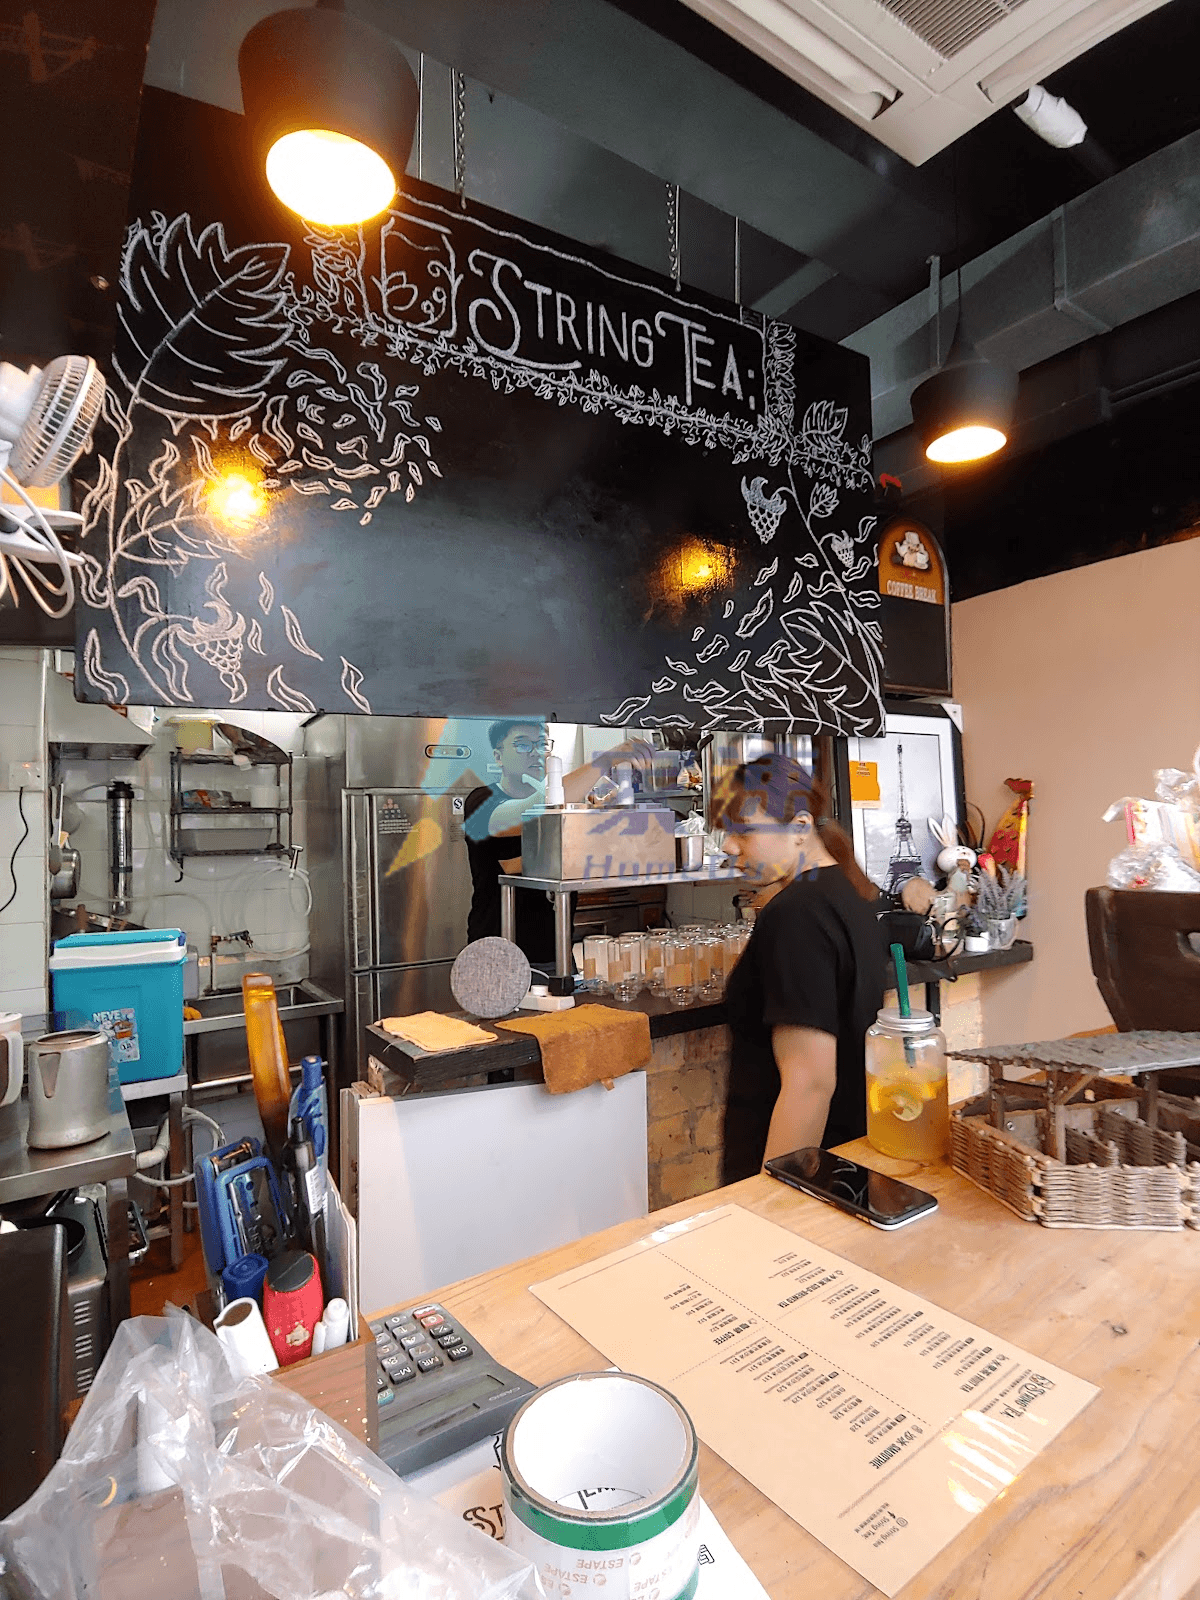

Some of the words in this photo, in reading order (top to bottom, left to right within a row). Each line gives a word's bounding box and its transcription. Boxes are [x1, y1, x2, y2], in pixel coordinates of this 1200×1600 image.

[468, 248, 654, 370] STRING
[886, 579, 914, 599] COFFEE
[914, 585, 937, 604] BREAK
[775, 1300, 790, 1308] TEA
[711, 1331, 736, 1345] COFFEE
[452, 1346, 468, 1356] ON
[422, 1356, 440, 1367] MR
[959, 1382, 974, 1393] TEA
[1007, 1381, 1047, 1409] STRING
[894, 1430, 917, 1447] 沙冰
[867, 1442, 902, 1469] SMOOTHIE
[576, 1558, 624, 1569] ESTAPE
[544, 1563, 589, 1584] ESTAPE
